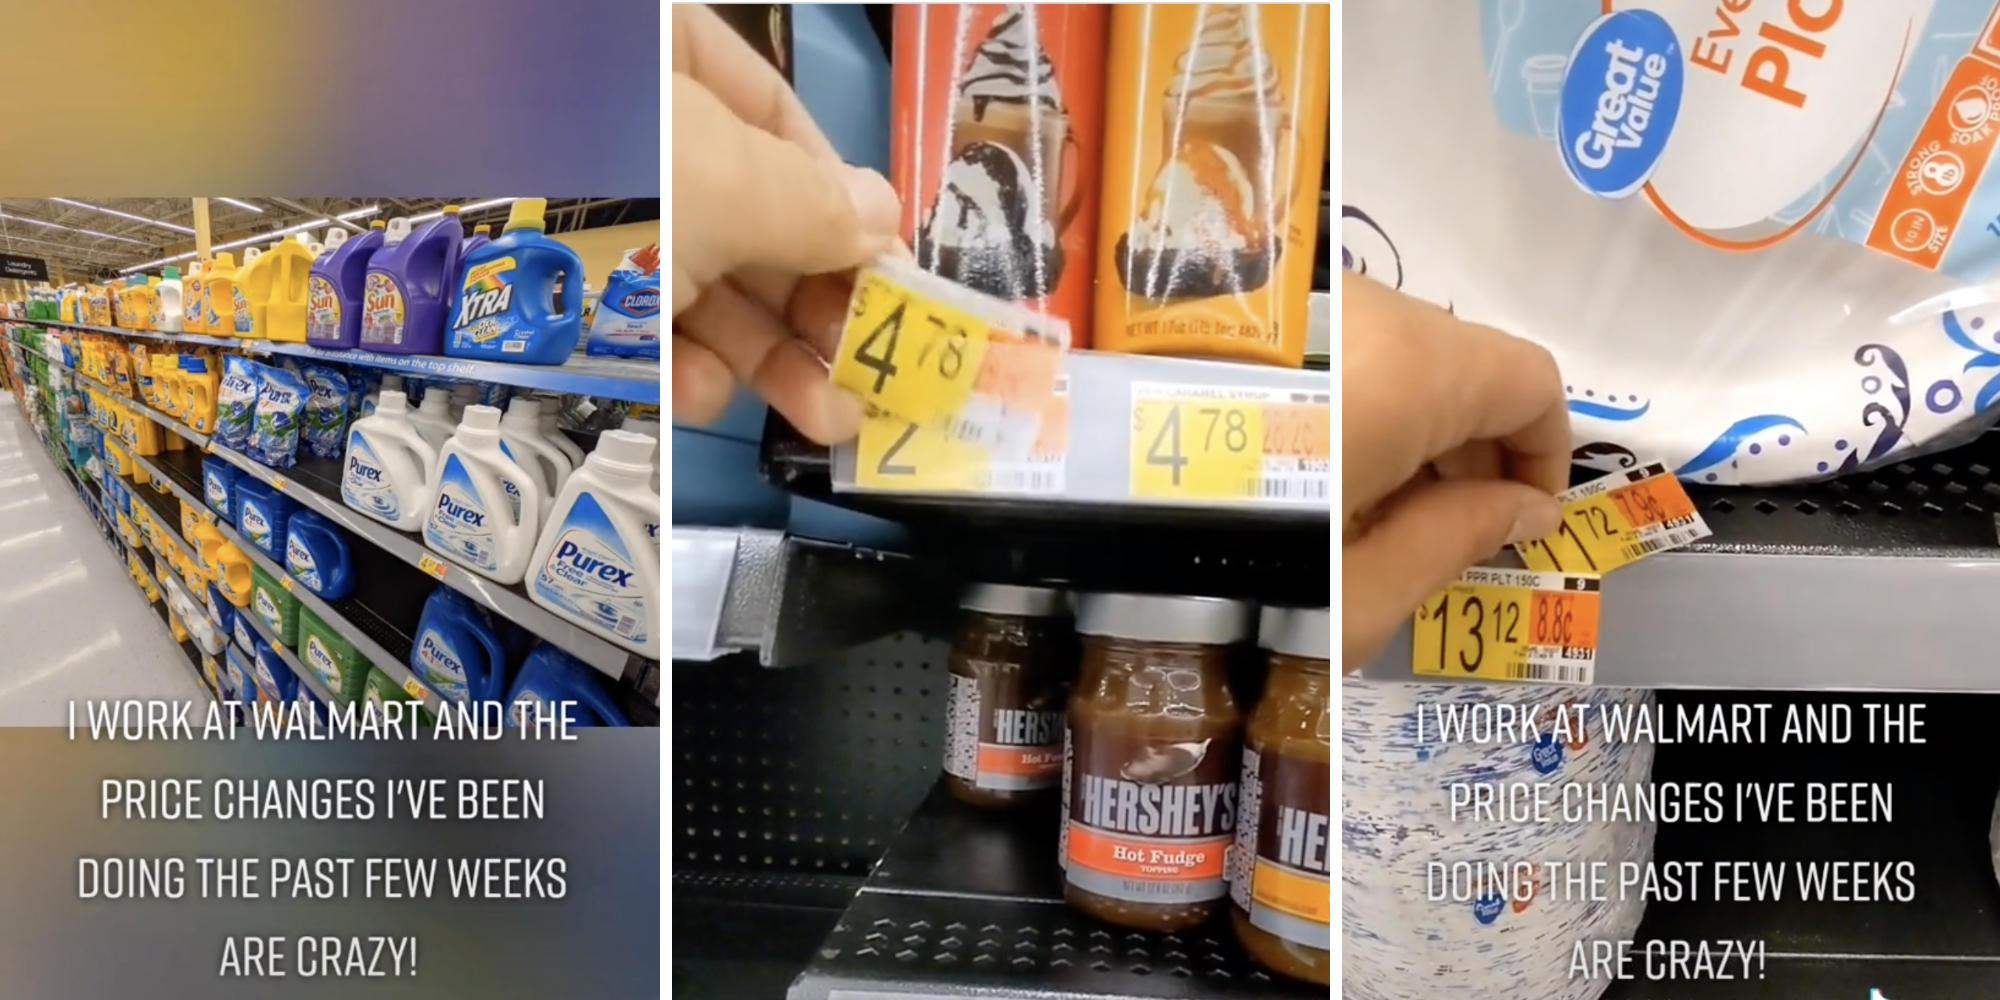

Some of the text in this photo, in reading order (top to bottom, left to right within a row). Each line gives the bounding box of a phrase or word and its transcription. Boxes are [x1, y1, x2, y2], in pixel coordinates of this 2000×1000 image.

[1575, 39, 1644, 169] Great
[1615, 53, 1667, 148] Value
[1949, 124, 1994, 146] SOAK
[1906, 140, 1942, 197] STRONG
[1927, 225, 1949, 254] SIZE
[311, 294, 333, 311] Sun
[367, 293, 395, 313] Sun
[453, 284, 512, 329] XTRA
[375, 354, 397, 366] items
[398, 357, 410, 366] on
[411, 357, 425, 368] the
[428, 360, 445, 372] top
[1198, 409, 1248, 452] 78
[350, 456, 382, 482] Purex
[244, 505, 265, 527] Purex
[438, 493, 485, 527] Purex
[1574, 506, 1618, 540] 72
[289, 539, 310, 562] Purex
[556, 540, 635, 588] Purex
[555, 569, 588, 587] Clear
[556, 560, 585, 579] Free
[1466, 572, 1490, 586] PPR
[1491, 573, 1511, 587] PLT
[1515, 575, 1541, 588] 150C
[1576, 579, 1586, 590] 9
[1493, 600, 1519, 643] 12
[310, 640, 333, 669] Purex
[424, 637, 461, 675] Purex
[1084, 775, 1237, 836] HERSHEY'S
[1113, 845, 1206, 865] Hot Fudge
[1140, 865, 1179, 874] TOPPING
